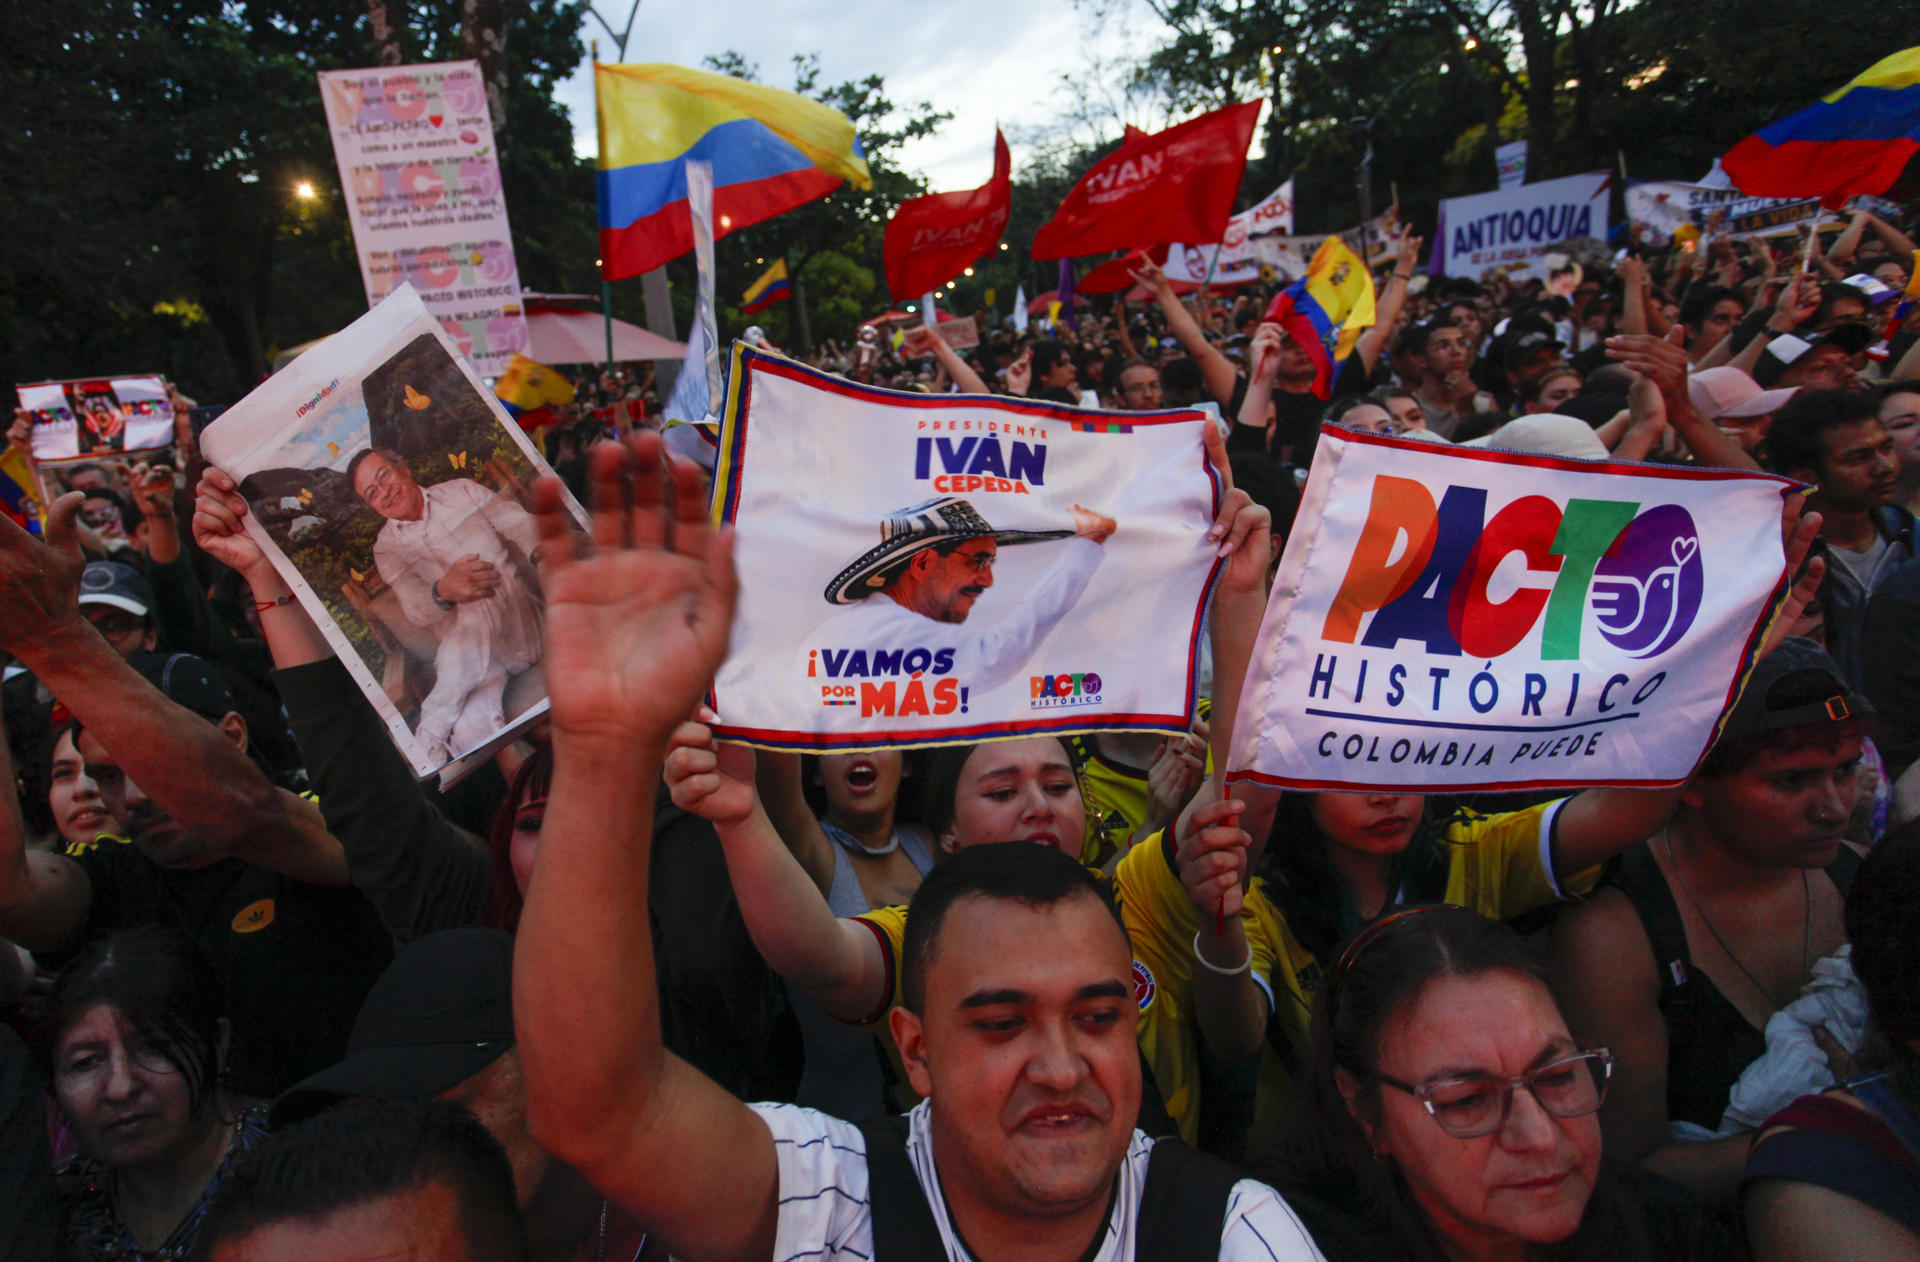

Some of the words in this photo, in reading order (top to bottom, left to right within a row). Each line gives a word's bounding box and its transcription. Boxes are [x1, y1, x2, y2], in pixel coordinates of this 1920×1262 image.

[416, 137, 458, 149] maestro
[1452, 204, 1592, 258] ANTIOQUIA
[31, 406, 73, 425] ACTO
[918, 420, 1048, 439] PRESIDENTE
[914, 432, 1048, 486] IVÁN
[933, 474, 1030, 495] CEPEDA
[1321, 474, 1704, 660] PACTO
[808, 647, 957, 679] ¡VAMOS
[821, 685, 856, 698] POR
[860, 671, 969, 718] MÁS!
[1030, 672, 1102, 699] PACTO
[1309, 652, 1668, 718] HISTÓRICO
[1317, 730, 1496, 767] COLOMBIA
[1509, 730, 1605, 765] PUEDE
